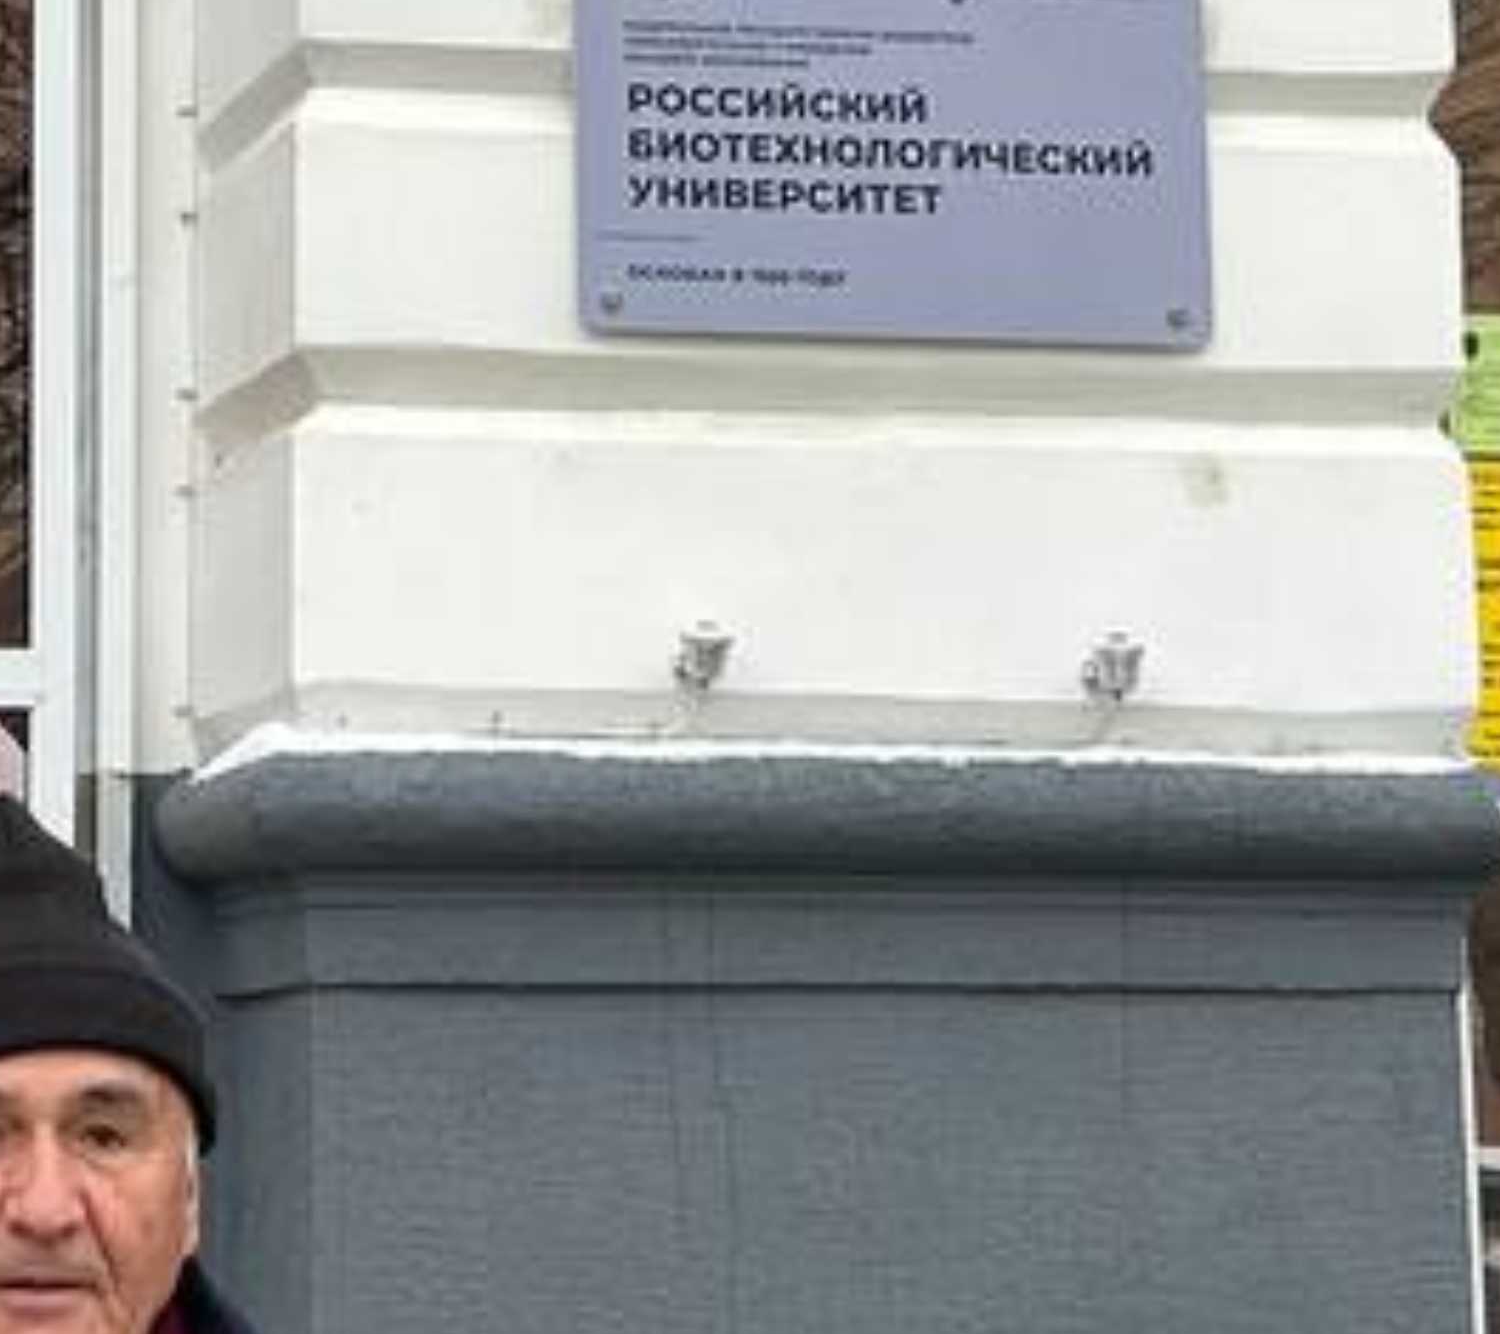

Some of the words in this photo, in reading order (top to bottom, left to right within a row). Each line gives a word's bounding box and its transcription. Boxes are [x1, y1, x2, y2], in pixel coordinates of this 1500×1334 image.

[626, 82, 928, 125] РОССИЙСКИЙ
[626, 129, 1154, 178] БИОТЕХНОЛОГИЧЕСКИЙ
[627, 176, 943, 215] УНИВЕРСИТЕТ
